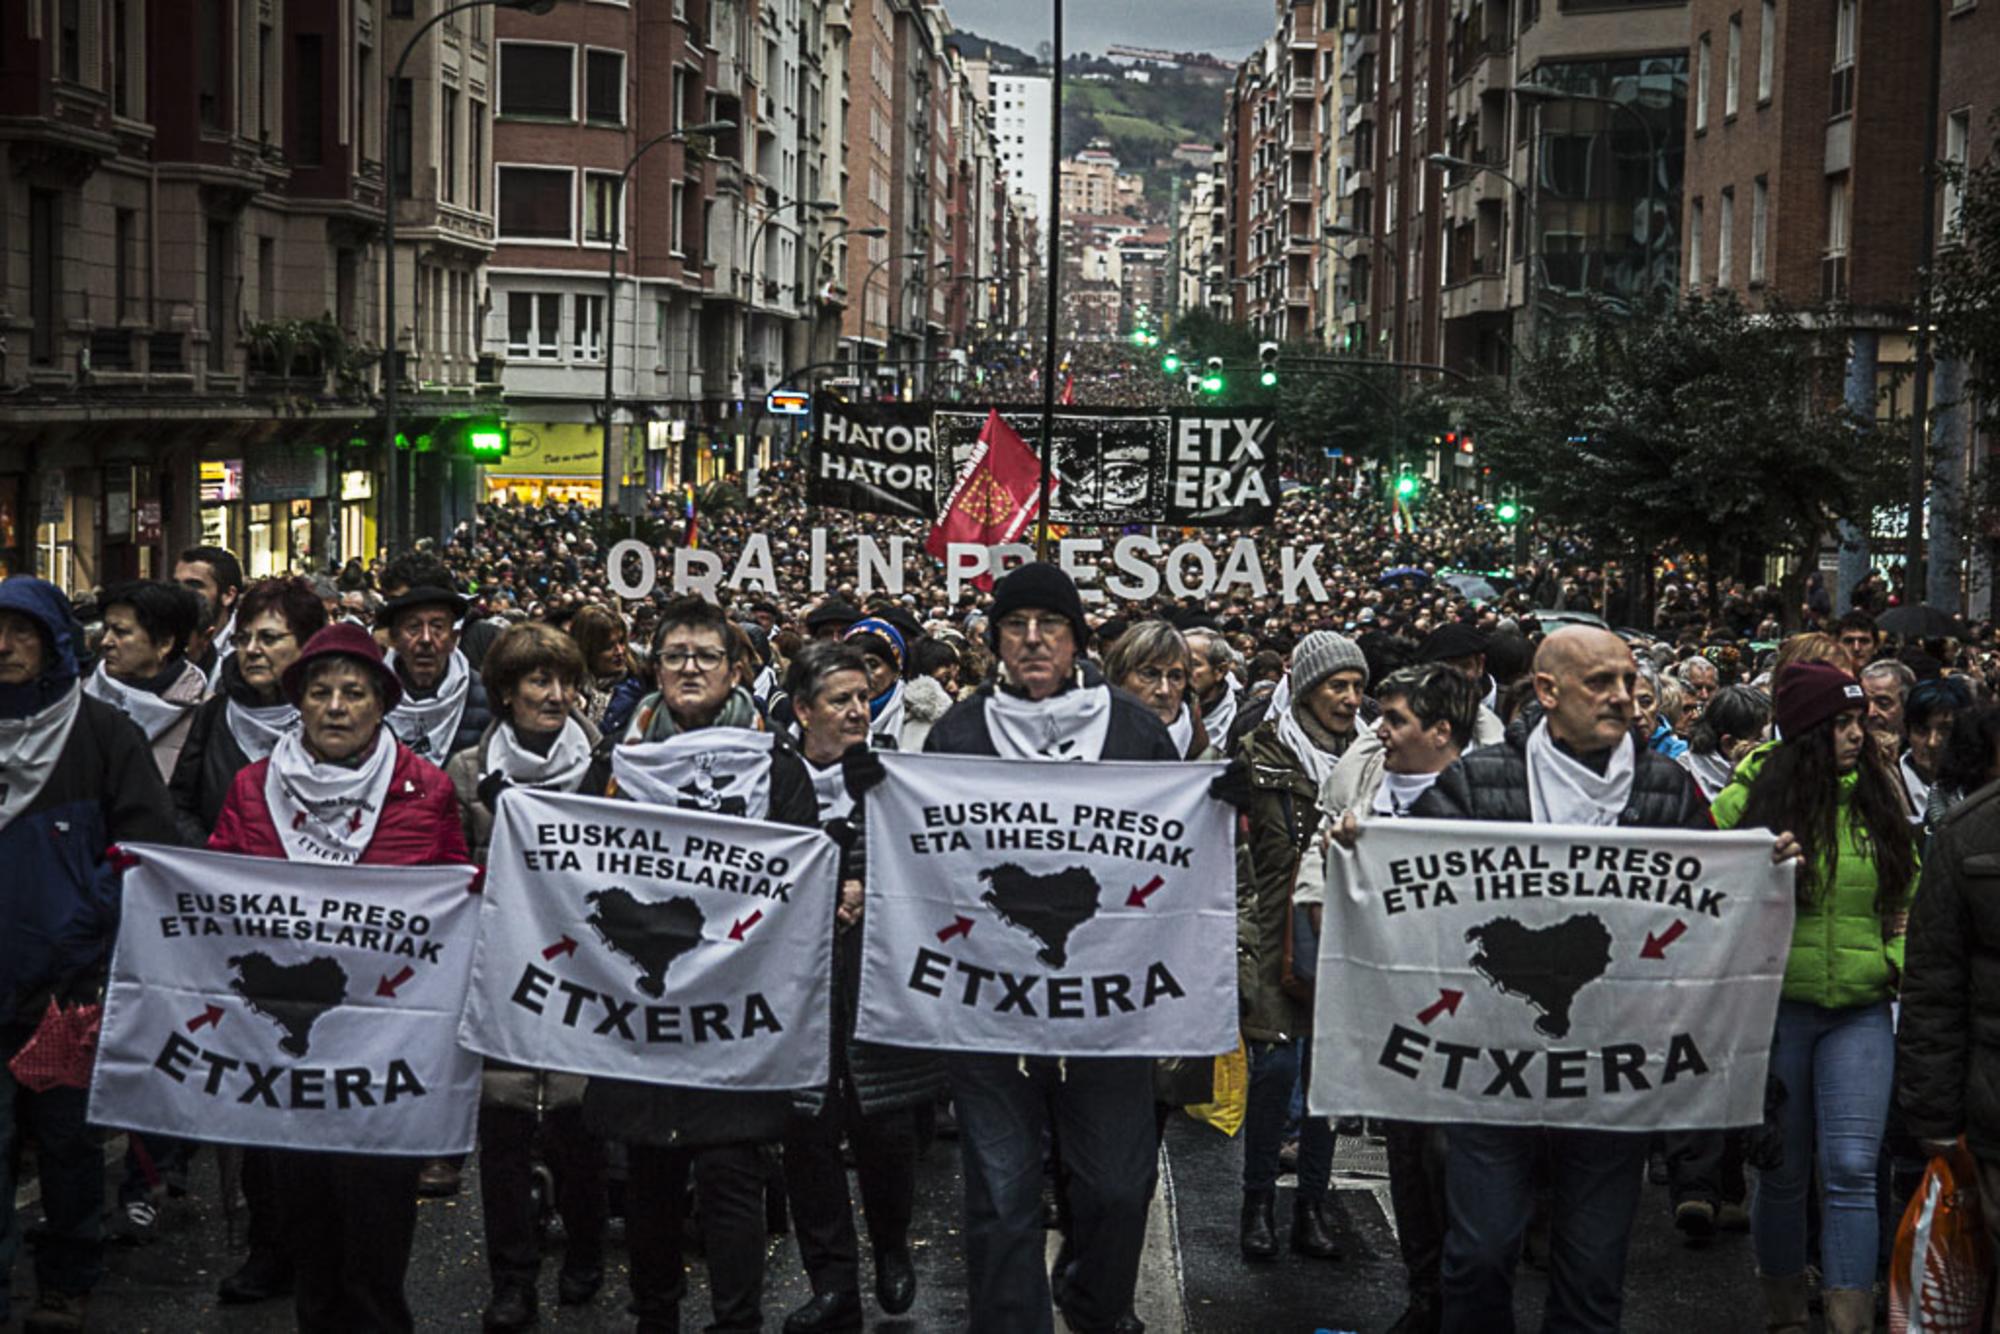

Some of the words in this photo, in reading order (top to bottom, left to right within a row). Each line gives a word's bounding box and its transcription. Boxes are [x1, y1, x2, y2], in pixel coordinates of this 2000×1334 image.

[823, 412, 934, 454] HATOR
[1177, 417, 1265, 461] ETX
[821, 451, 934, 491] HATOR
[1174, 465, 1272, 509] ERA
[606, 527, 905, 605] ORAIN
[921, 801, 1059, 829] EUSKAL
[1073, 803, 1185, 843] PRESO
[537, 823, 670, 855] EUSKAL
[683, 834, 791, 878] PRESO
[909, 831, 973, 855] ETA
[985, 828, 1195, 869] IHESLARIAK
[1388, 844, 1550, 886] EUSKAL
[1568, 844, 1703, 883] PRESO
[524, 849, 582, 872] ETA
[597, 851, 795, 907] IHESLARIAK
[1382, 880, 1459, 916] ETA
[1474, 871, 1728, 919] IHESLARIAK
[175, 891, 307, 918] EUSKAL
[320, 898, 432, 938] PRESO
[159, 915, 224, 939] ETA
[232, 917, 445, 965] IHESLARIAK
[510, 962, 784, 1044] ETXERA
[907, 946, 1187, 1020] ETXERA
[154, 1030, 428, 1110] ETXERA
[1378, 1023, 1710, 1100] ETXERA
